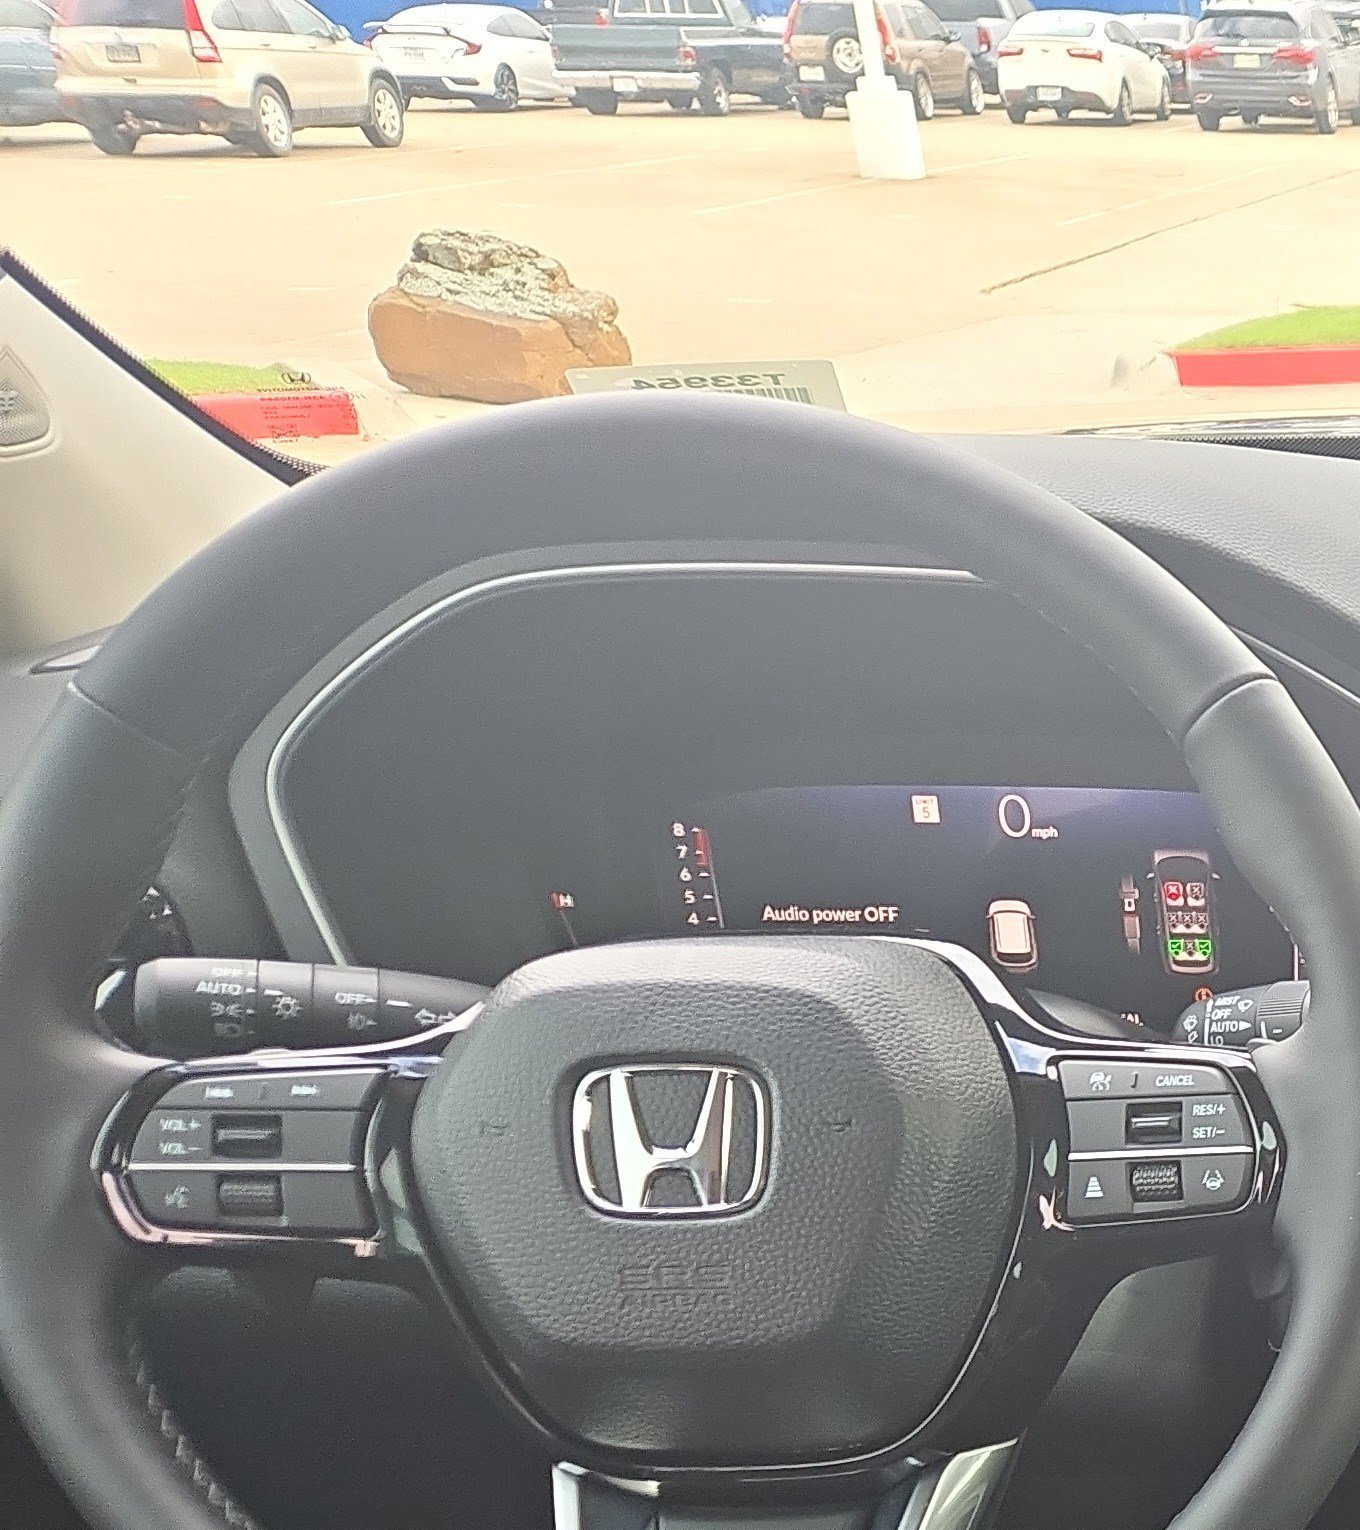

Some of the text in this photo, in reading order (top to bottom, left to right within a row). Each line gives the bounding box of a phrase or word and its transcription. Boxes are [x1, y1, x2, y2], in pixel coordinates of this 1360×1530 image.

[922, 806, 931, 819] 5
[998, 794, 1059, 840] 0 mph
[672, 822, 686, 838] 8
[675, 844, 689, 859] 7
[678, 866, 693, 882] 6
[684, 888, 697, 904] 5
[686, 911, 700, 925] 4
[762, 904, 899, 924] Audio power OFF
[195, 981, 242, 995] AUTO
[1211, 1008, 1232, 1020] OFF
[1209, 1021, 1239, 1033] AUTO
[1155, 1075, 1195, 1087] CANCEL
